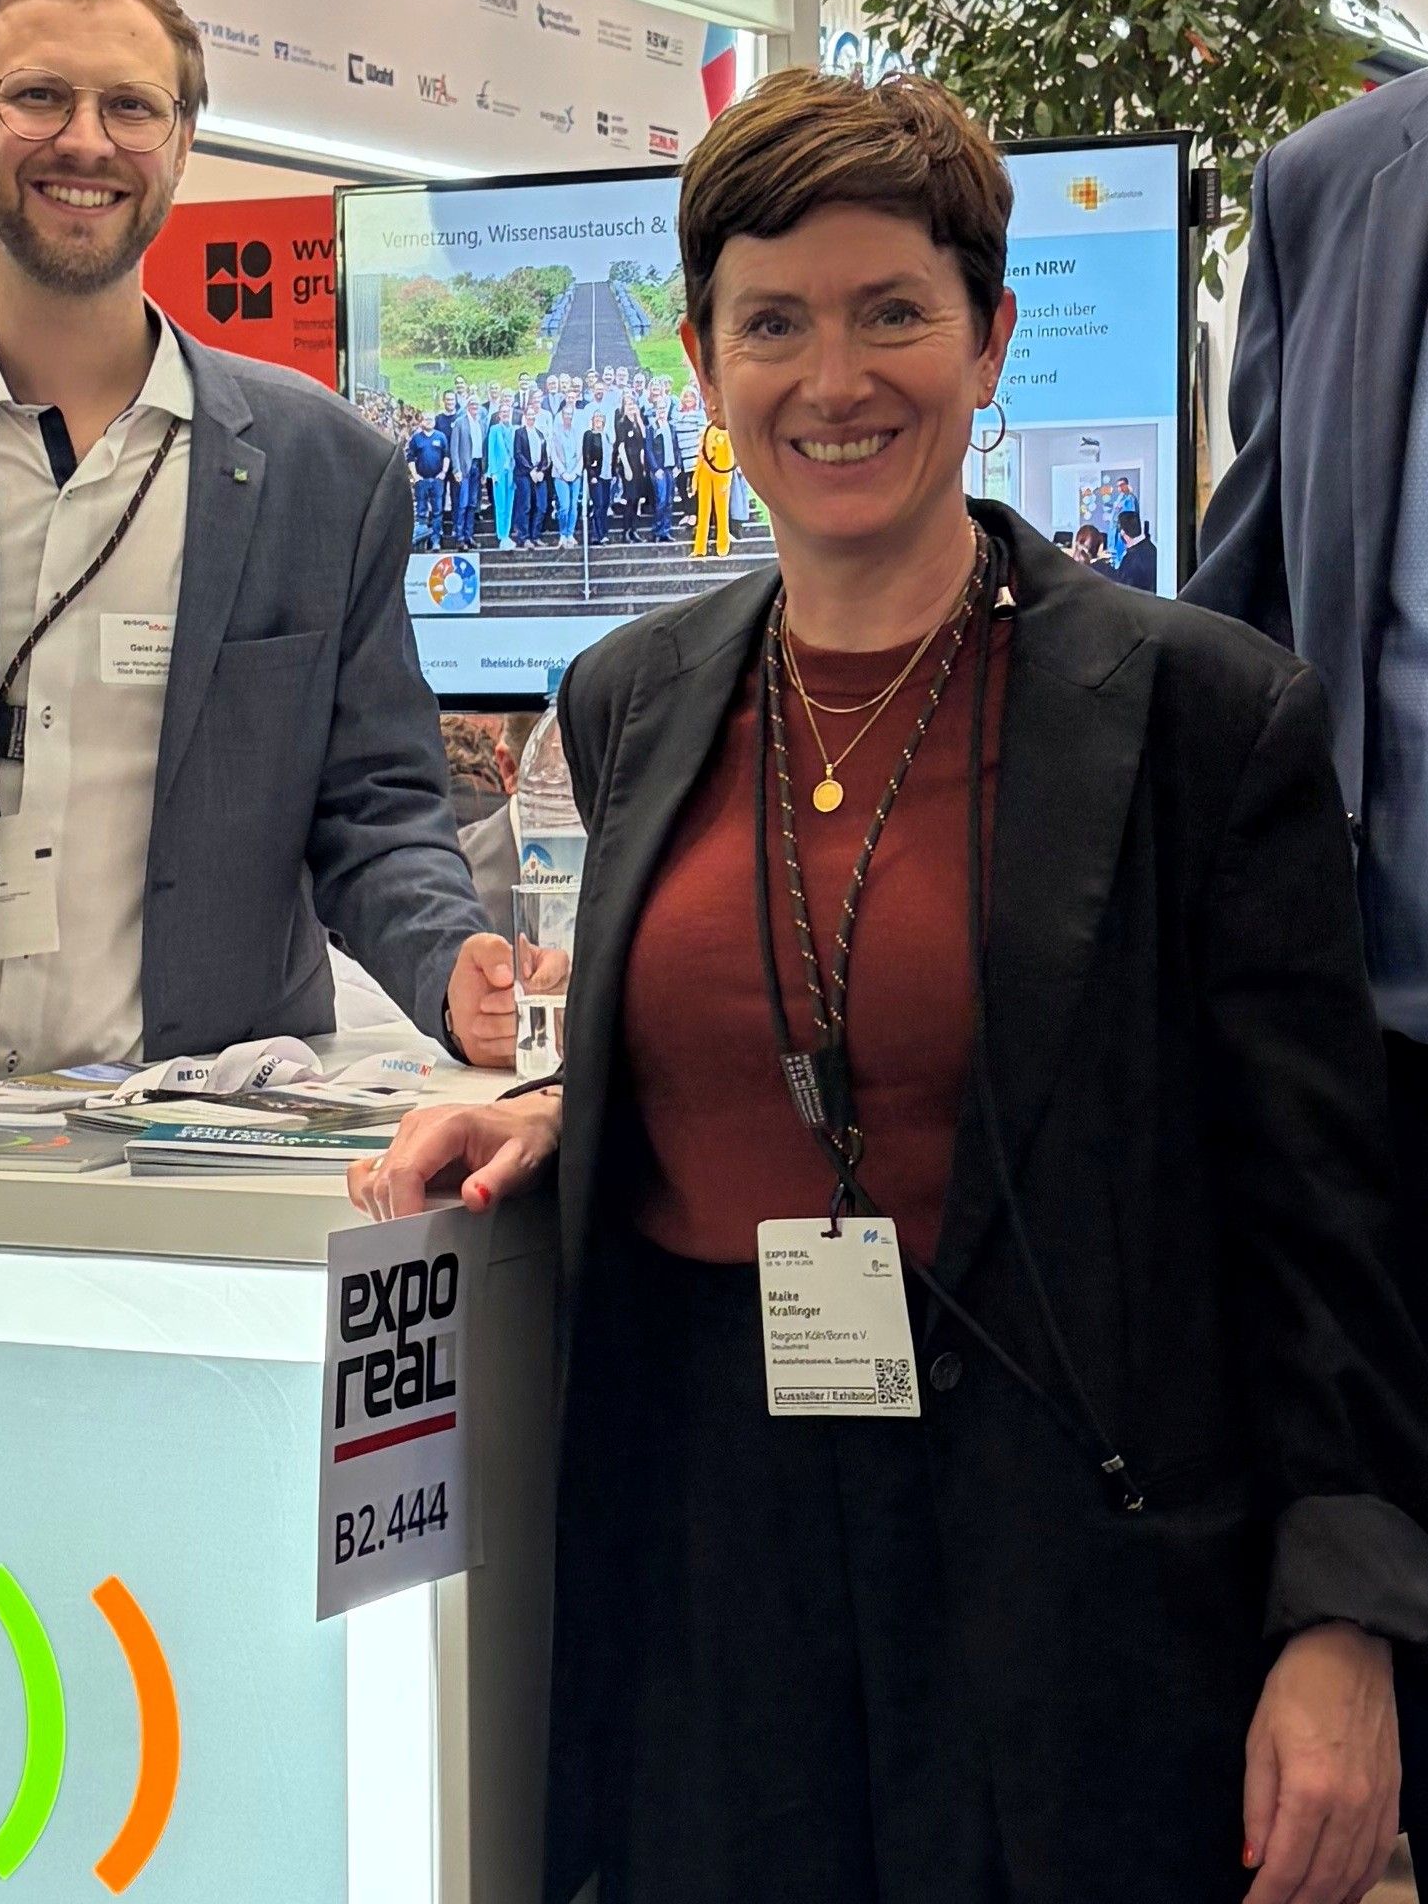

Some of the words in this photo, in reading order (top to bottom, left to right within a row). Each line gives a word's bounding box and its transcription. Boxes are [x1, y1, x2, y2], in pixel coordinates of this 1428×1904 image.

[381, 228, 483, 249] Vernetzung,
[487, 216, 645, 244] Wissensaustausch
[650, 215, 667, 235] &
[1035, 259, 1077, 277] NRW
[1064, 302, 1097, 317] über
[1037, 322, 1109, 339] innovative
[1030, 369, 1058, 385] und
[339, 1251, 459, 1360] expo
[334, 1334, 457, 1431] real
[334, 1480, 450, 1566] B2.444
